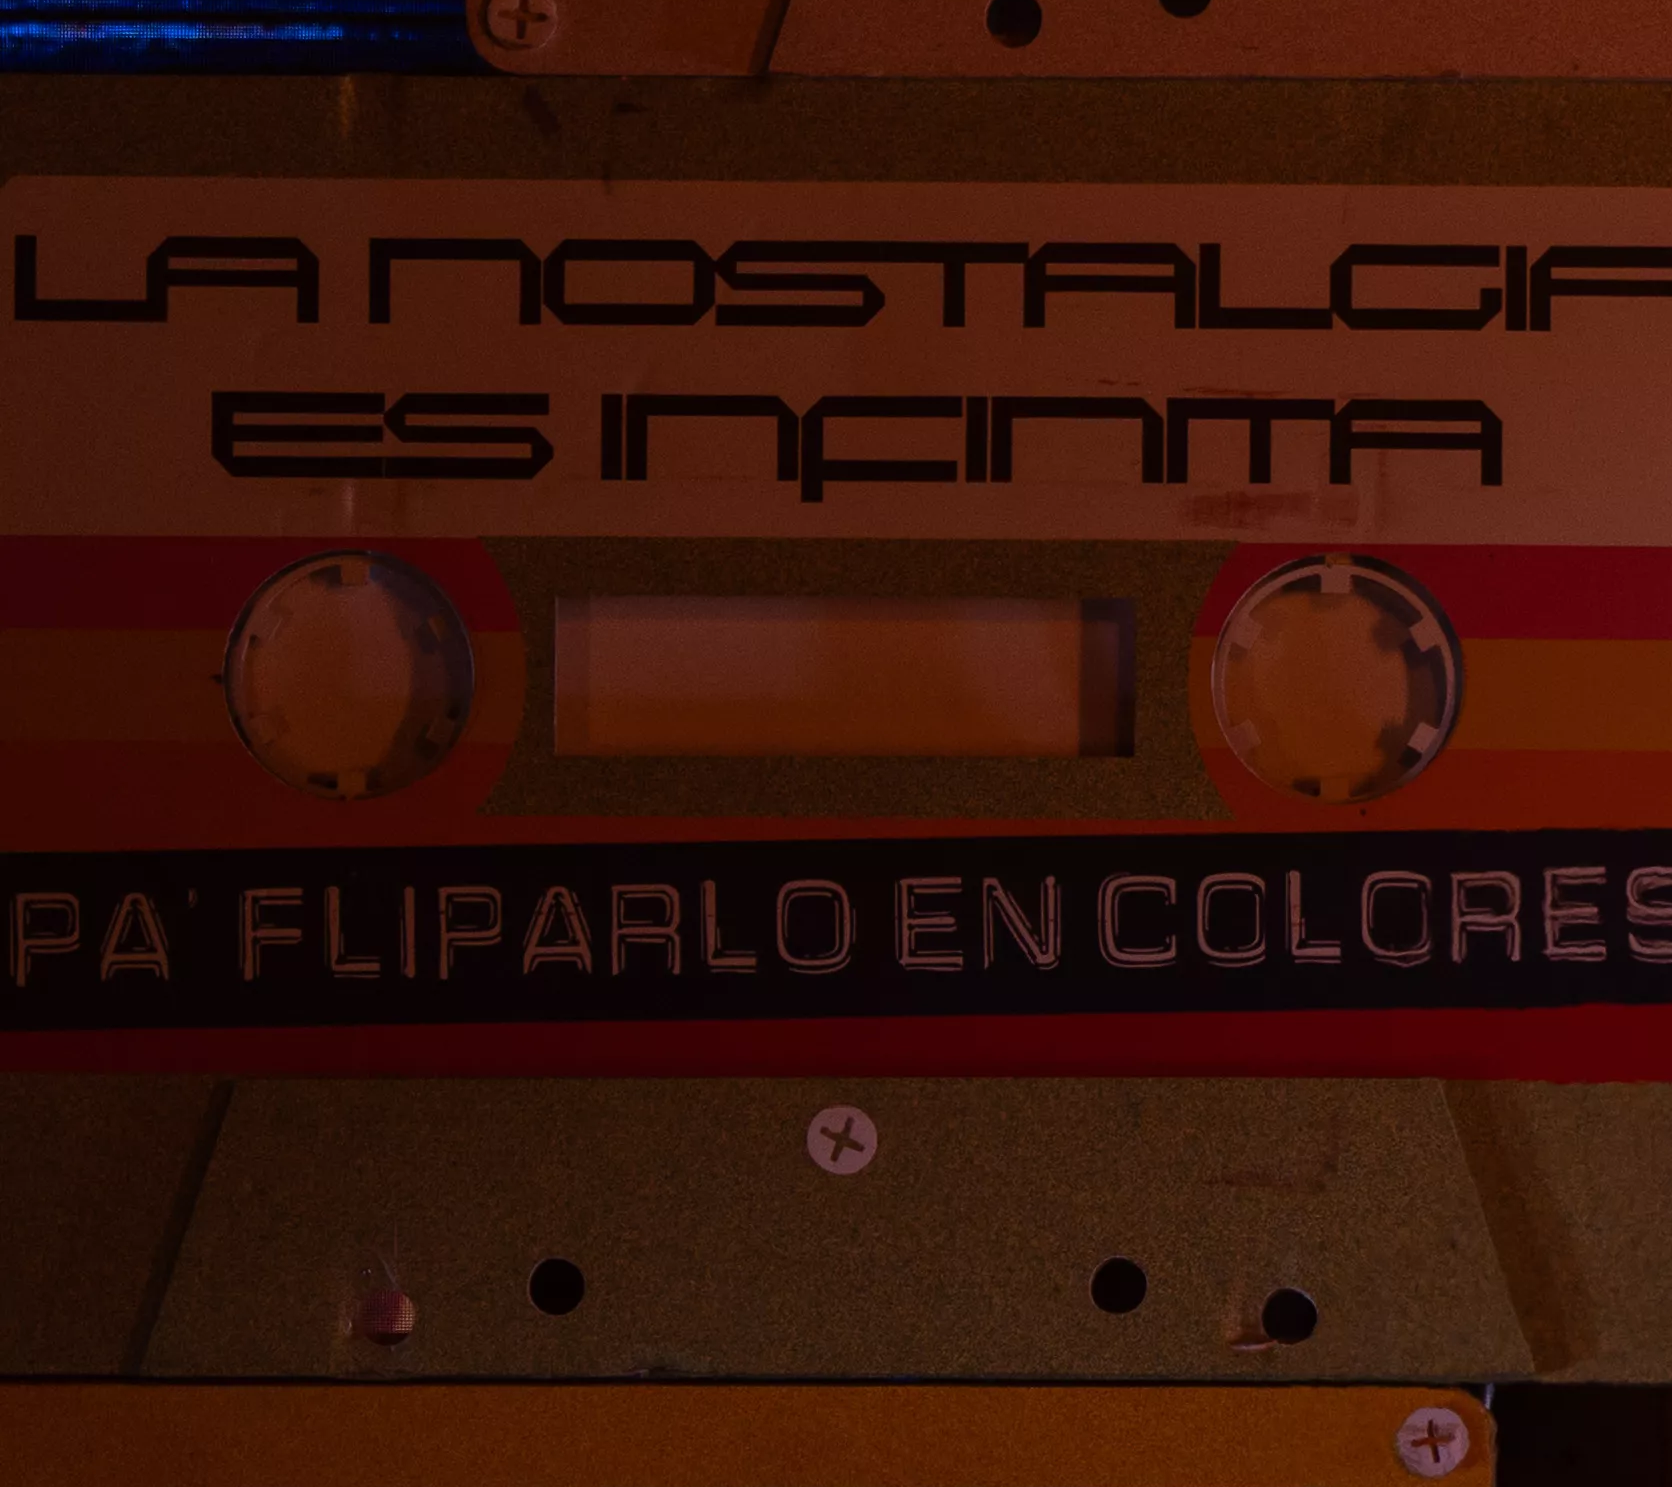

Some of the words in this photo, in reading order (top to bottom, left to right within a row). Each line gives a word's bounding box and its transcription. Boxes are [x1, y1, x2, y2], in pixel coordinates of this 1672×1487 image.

[13, 236, 319, 323] LA
[211, 391, 554, 481] ES
[239, 877, 856, 980] FLIPARLO
[895, 874, 1064, 972] EN
